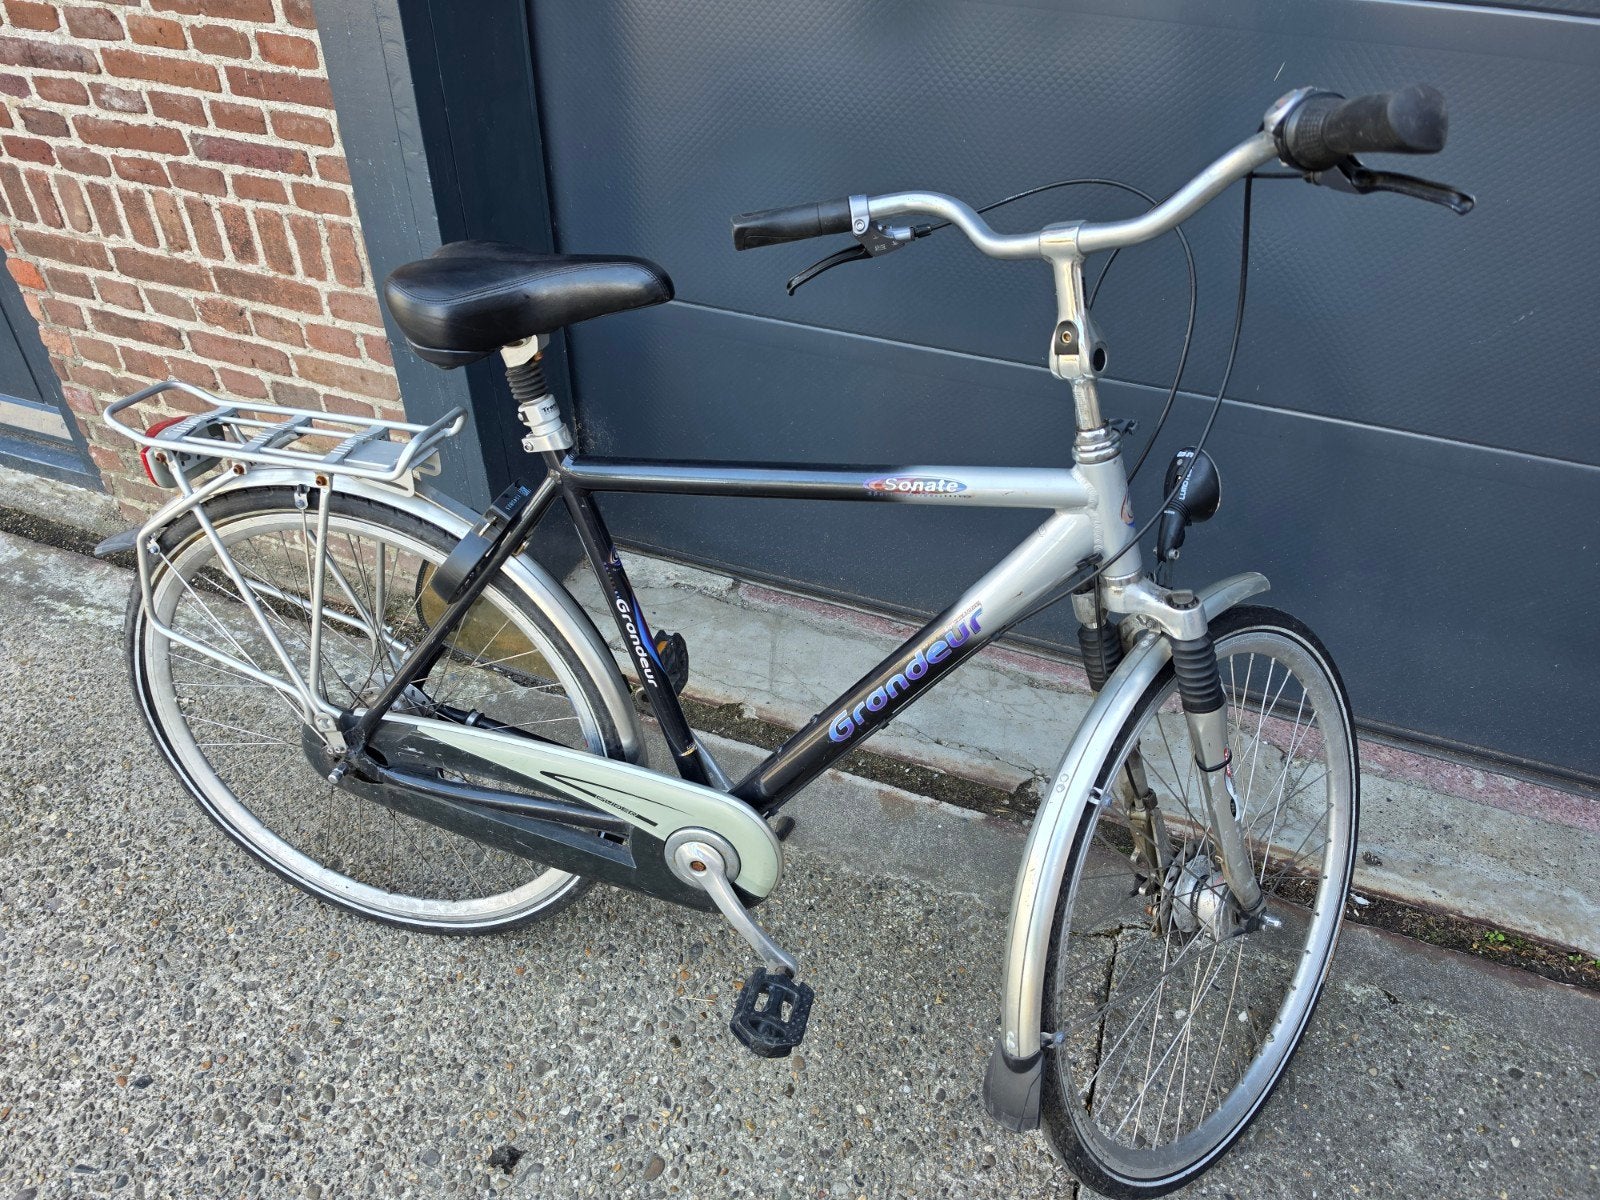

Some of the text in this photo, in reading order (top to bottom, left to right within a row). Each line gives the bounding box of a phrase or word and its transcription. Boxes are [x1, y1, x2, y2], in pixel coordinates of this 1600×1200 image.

[884, 478, 959, 492] Sonate
[616, 598, 658, 688] Grandeur
[828, 607, 984, 743] Grandeur
